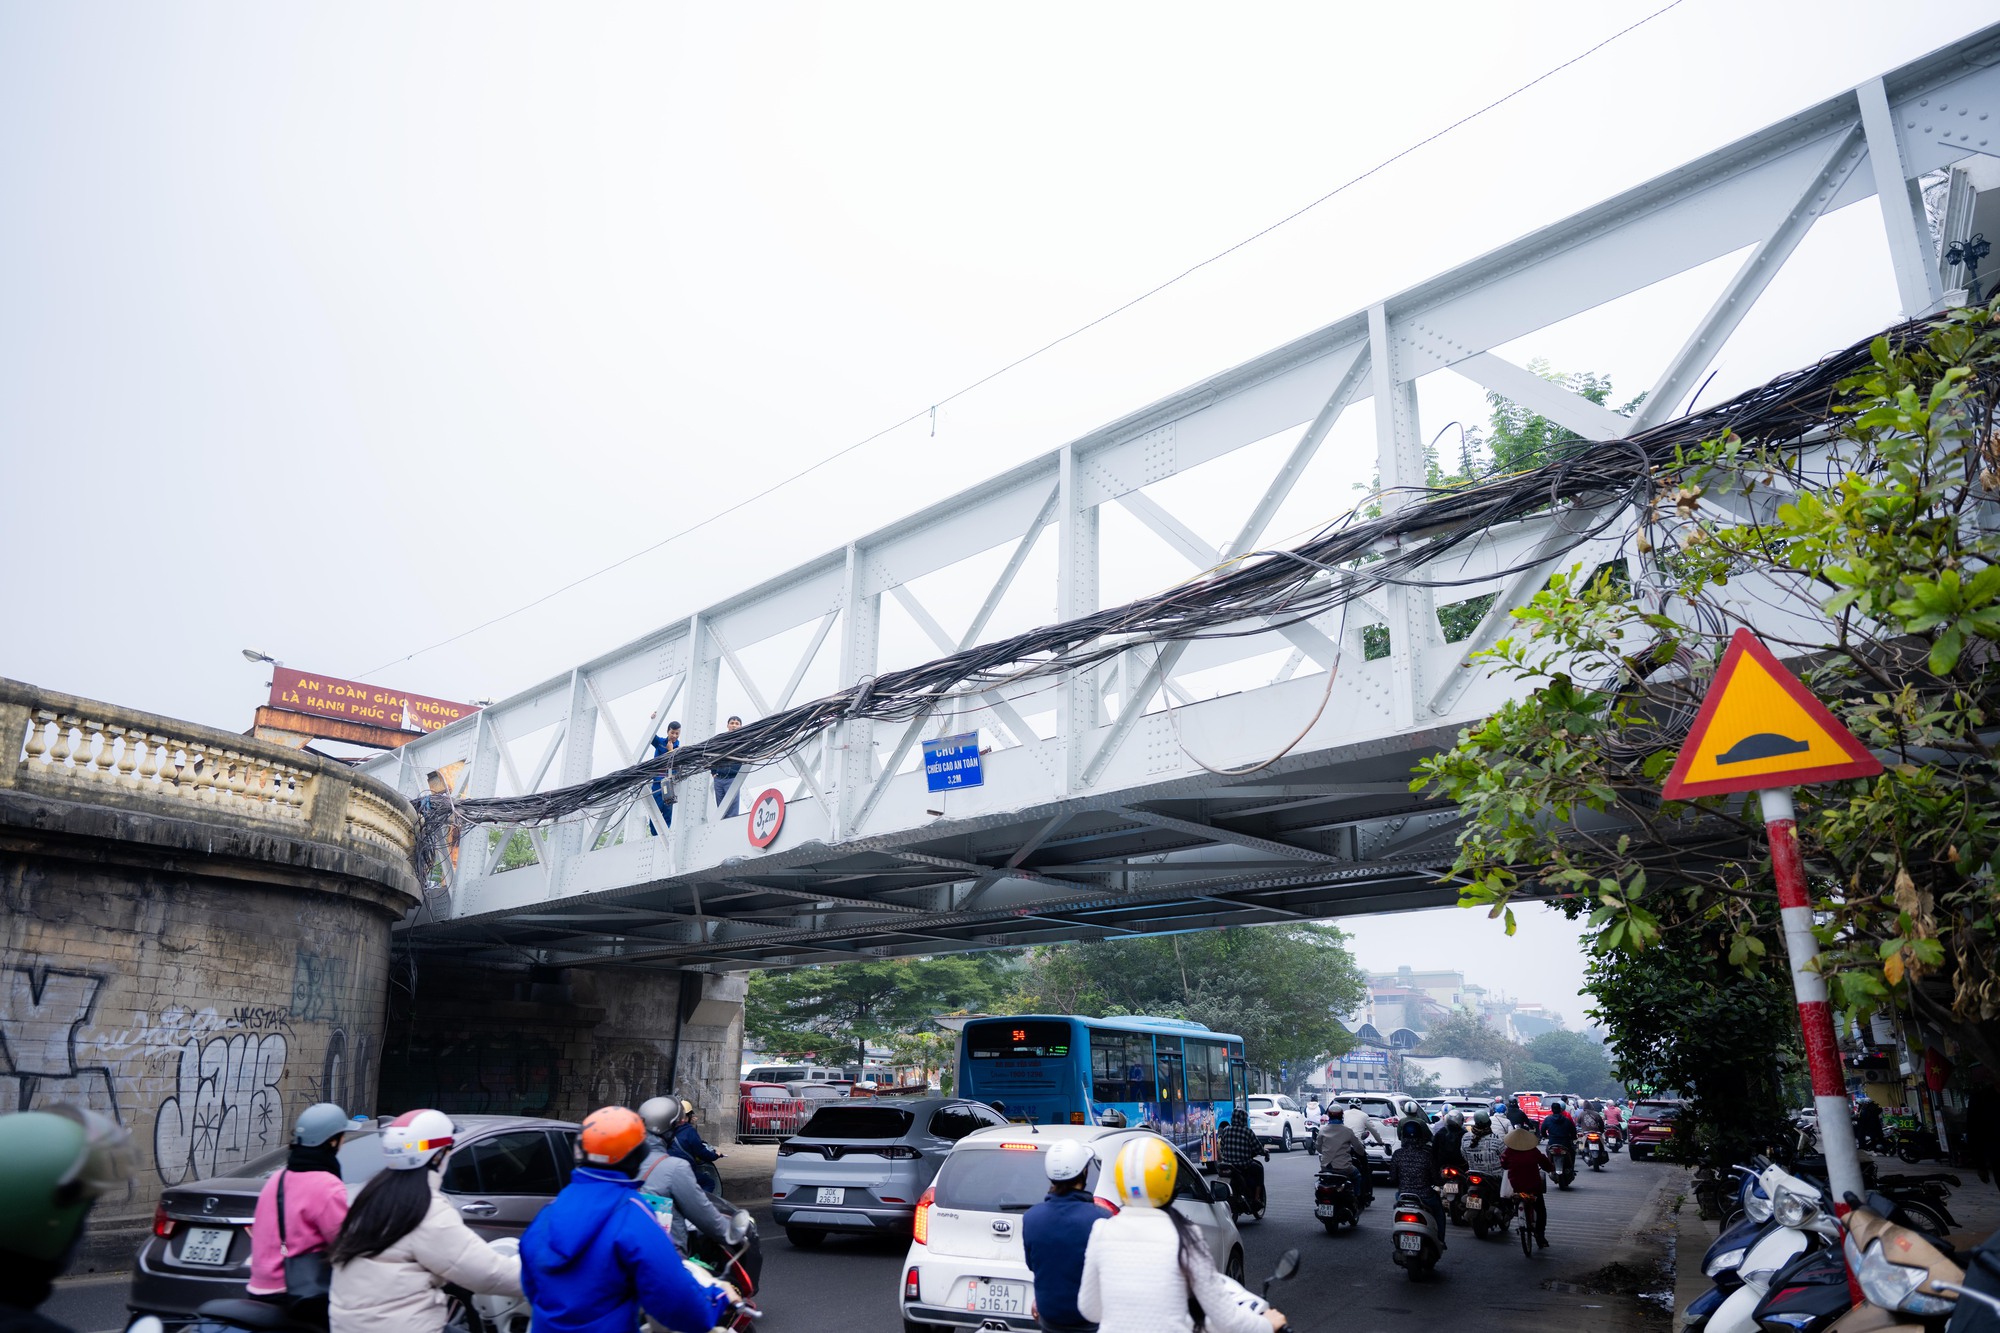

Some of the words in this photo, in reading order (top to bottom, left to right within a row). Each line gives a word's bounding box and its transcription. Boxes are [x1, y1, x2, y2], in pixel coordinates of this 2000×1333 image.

[281, 690, 300, 704] LÀ
[306, 696, 345, 712] HẠNH
[350, 704, 385, 719] PHÚC
[298, 679, 319, 691] AN
[327, 684, 367, 700] TOÀN
[415, 701, 459, 718] THÔNG
[942, 761, 954, 772] CAO
[954, 760, 963, 770] AN
[756, 808, 776, 830] 3,2m
[1012, 1030, 1025, 1040] 54
[824, 1188, 836, 1196] 30K
[819, 1195, 840, 1204] 236.31
[993, 1222, 1009, 1231] KIA
[989, 1284, 1010, 1298] 89A
[979, 1297, 1018, 1311] 316.17
